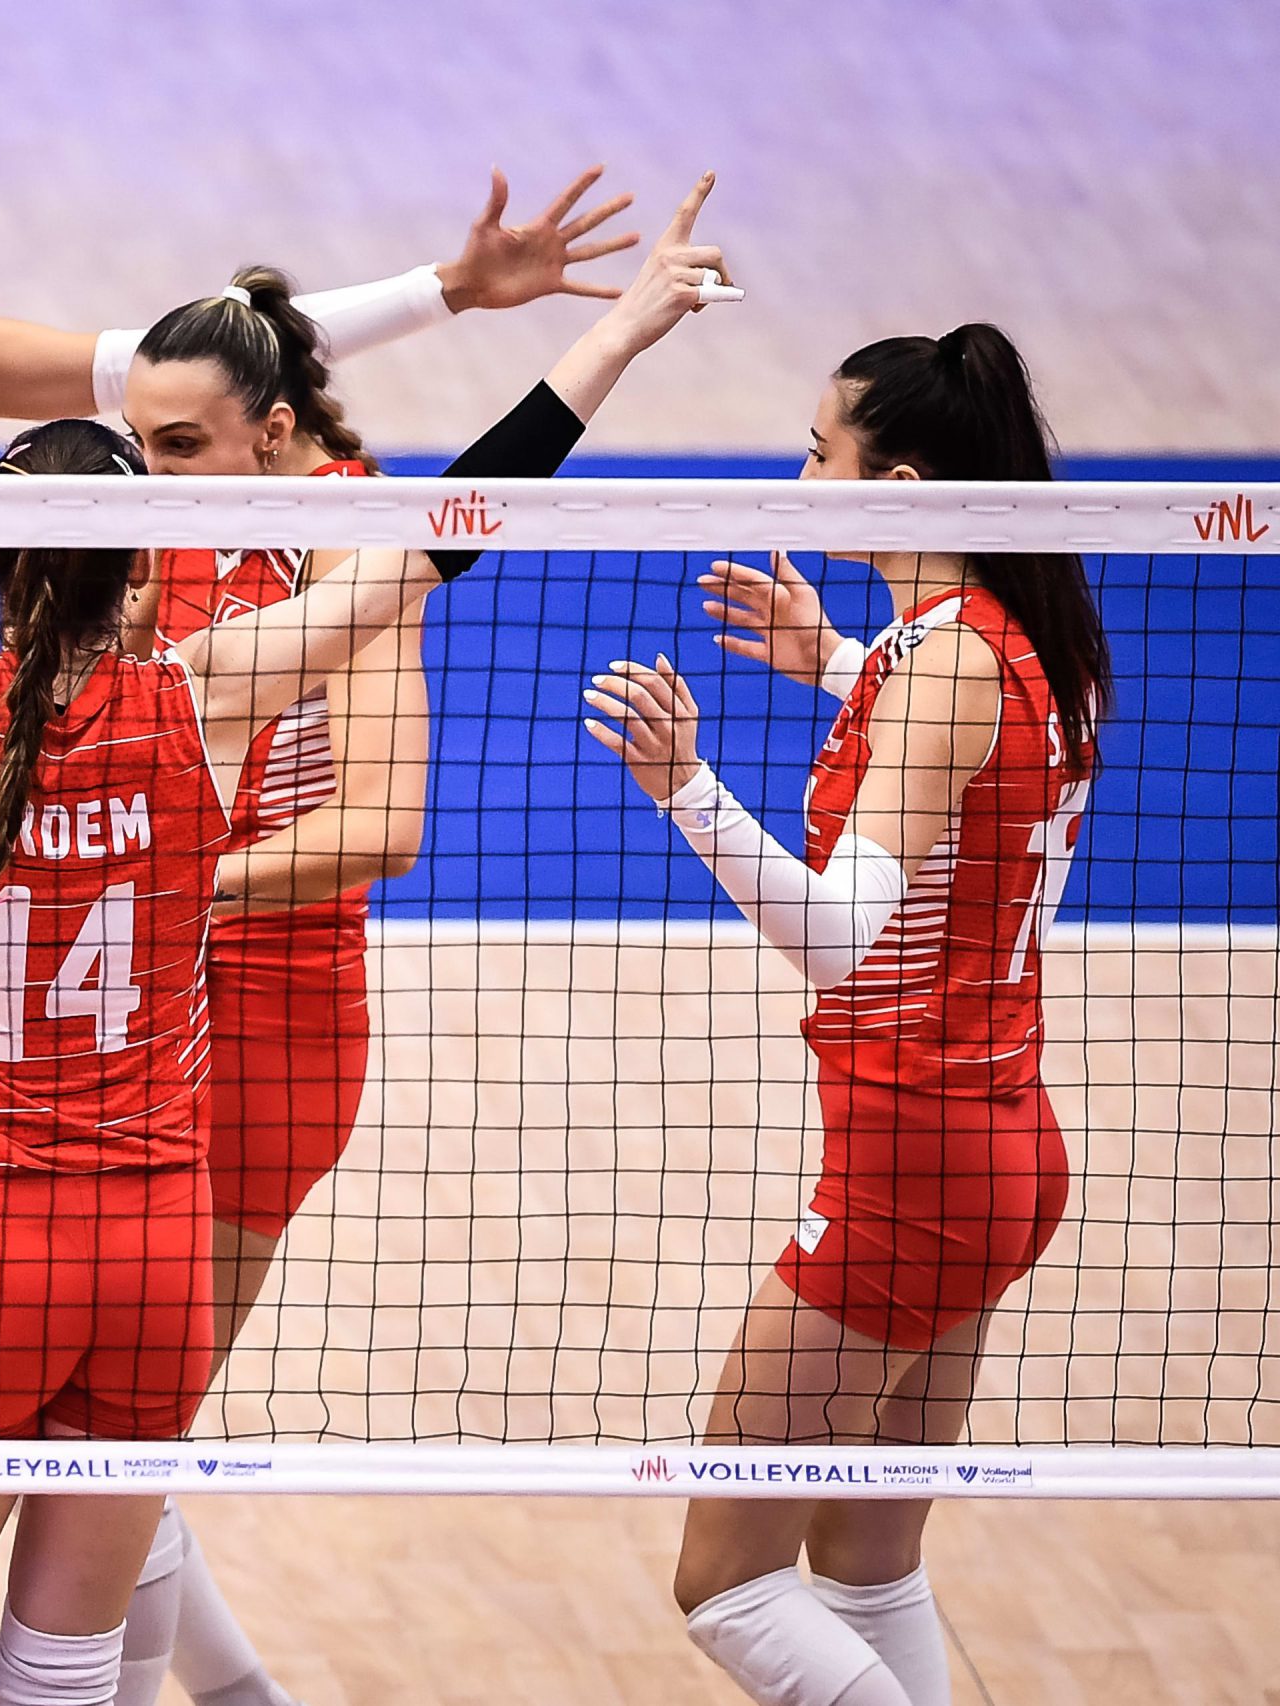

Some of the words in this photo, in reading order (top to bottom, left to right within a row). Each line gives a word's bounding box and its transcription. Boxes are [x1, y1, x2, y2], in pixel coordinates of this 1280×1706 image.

[428, 490, 503, 538] VNL
[1193, 493, 1270, 543] VNL
[123, 1458, 179, 1468] NATIONS
[631, 1455, 678, 1482] VNL
[688, 1462, 878, 1484] VOLLEYBALL
[883, 1465, 939, 1475] NATIONS
[883, 1476, 933, 1485] LEAGUE
